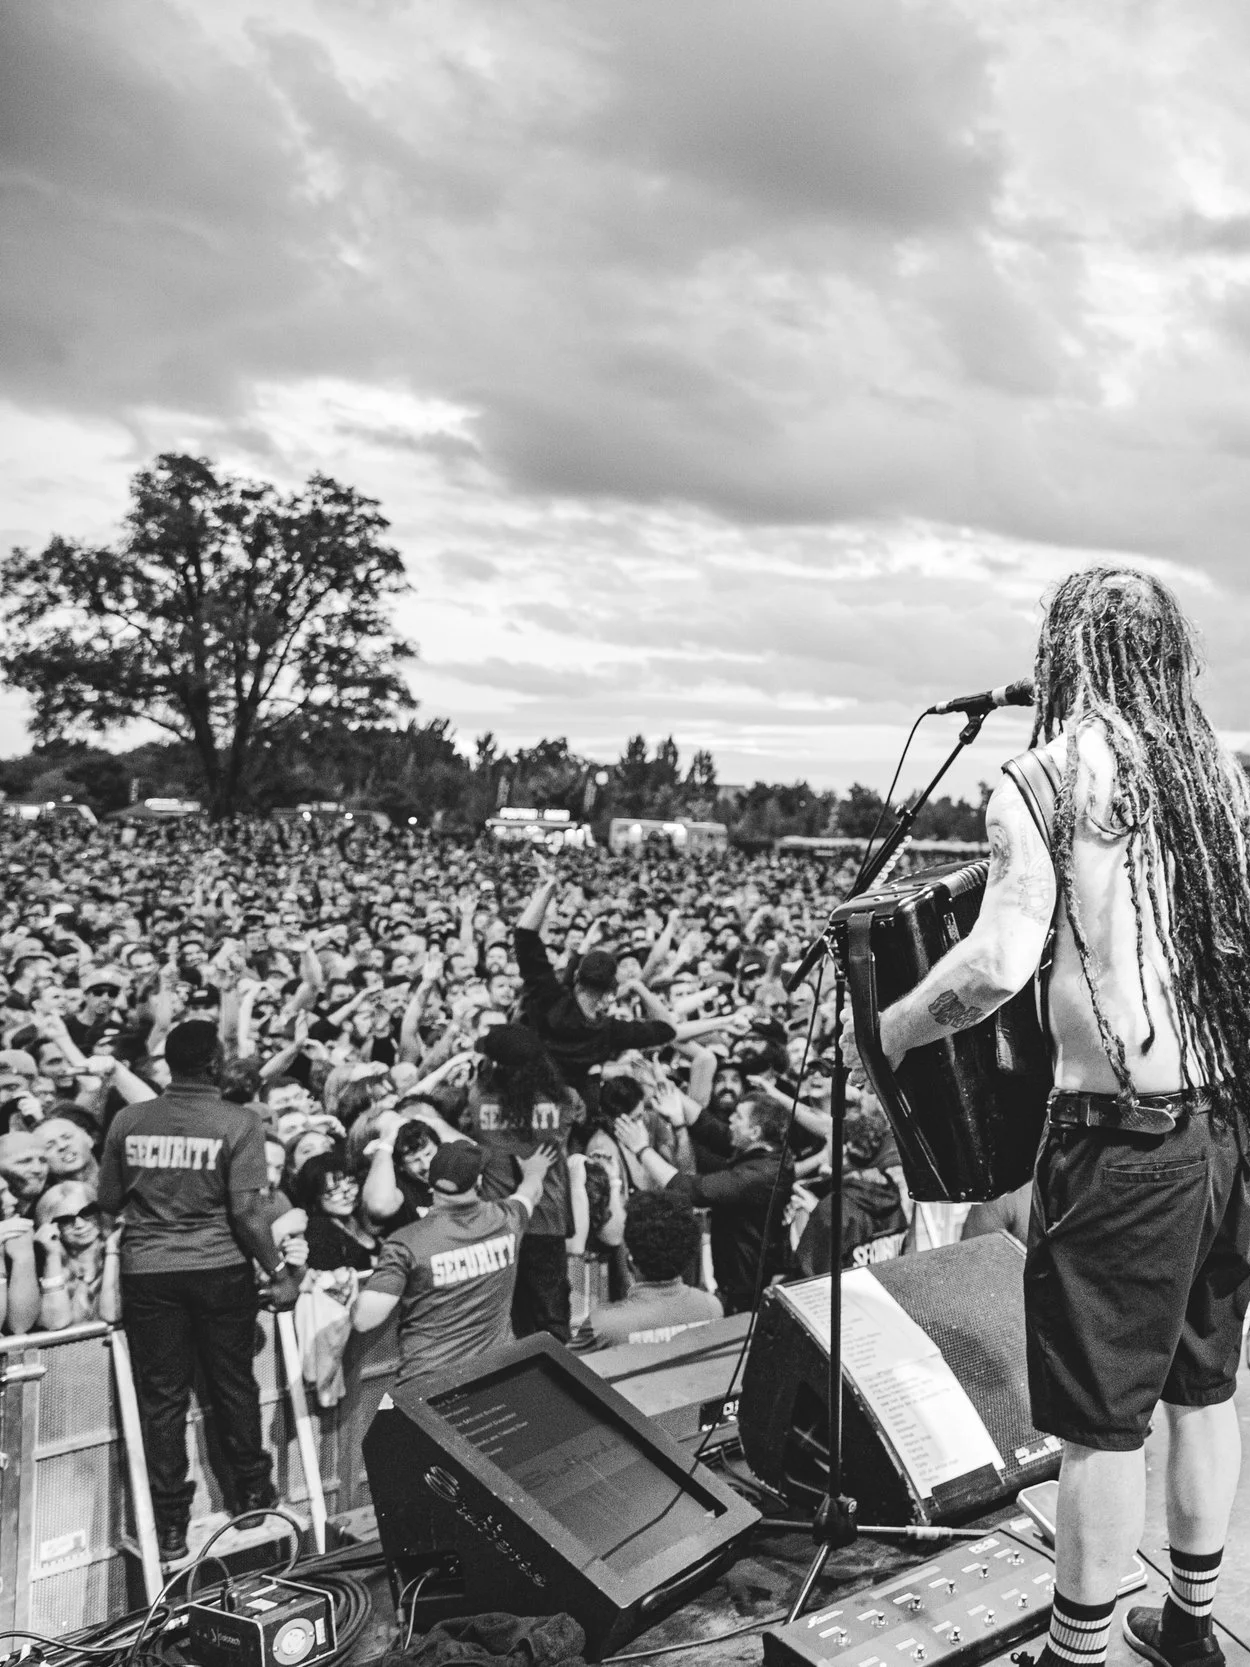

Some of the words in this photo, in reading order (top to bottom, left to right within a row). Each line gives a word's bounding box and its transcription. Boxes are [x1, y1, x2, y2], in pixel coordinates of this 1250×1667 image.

[480, 1103, 560, 1130] SEITY
[125, 1135, 223, 1170] SECURITY
[430, 1233, 516, 1287] SECURITY
